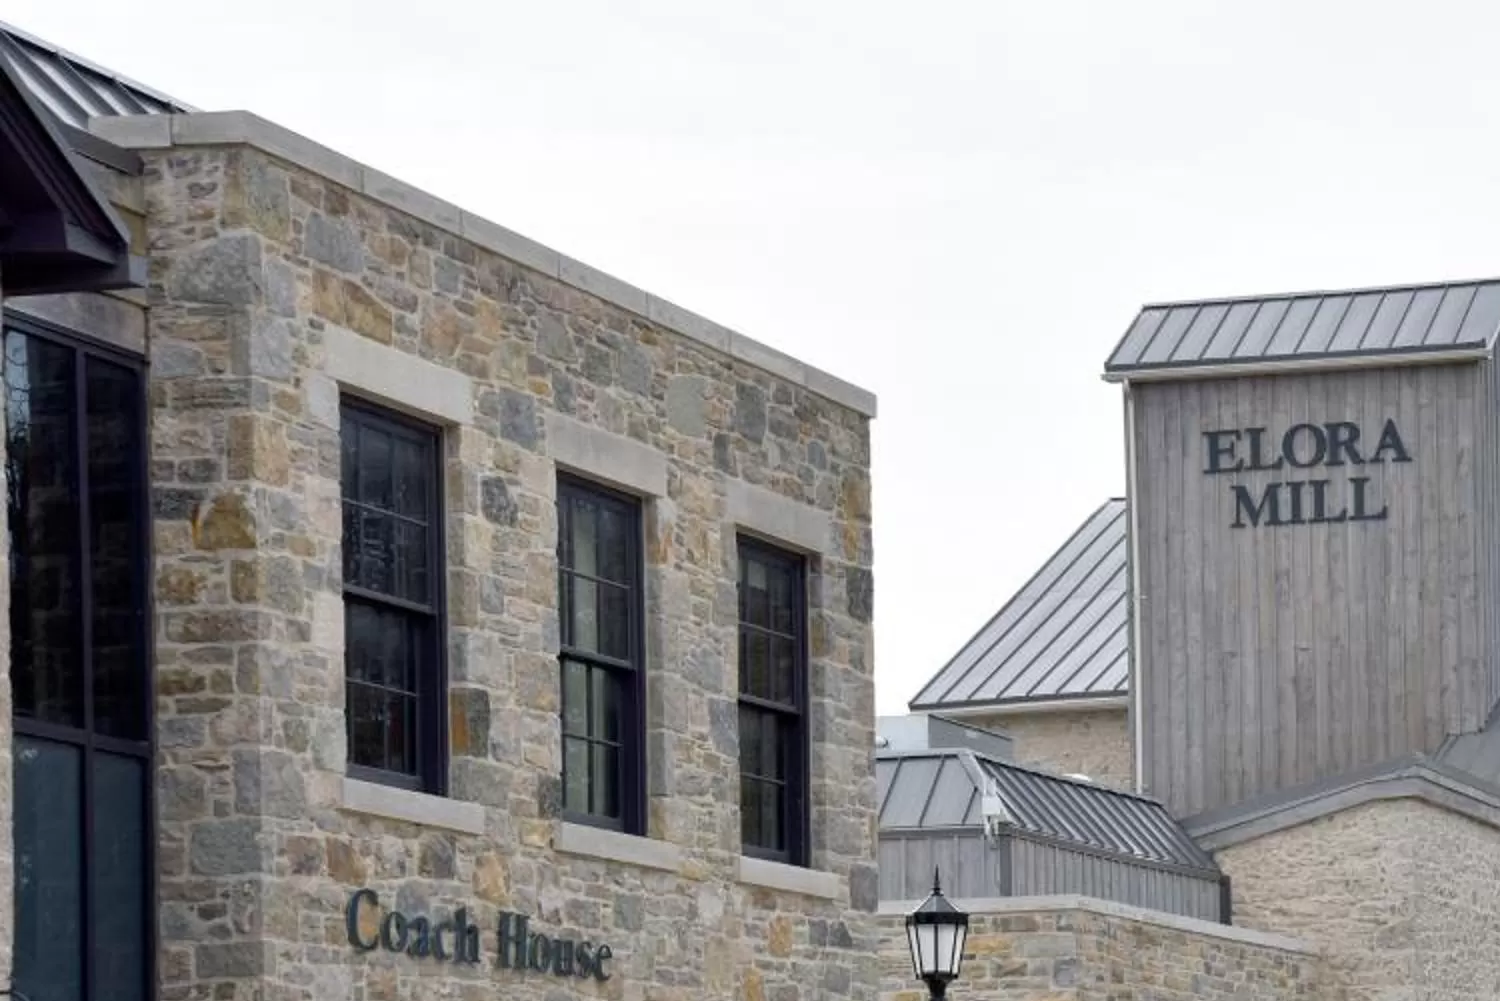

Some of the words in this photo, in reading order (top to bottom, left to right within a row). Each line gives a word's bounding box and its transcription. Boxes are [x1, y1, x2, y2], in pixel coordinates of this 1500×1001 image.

[1202, 418, 1412, 474] ELORA
[1230, 477, 1388, 528] MILL
[346, 888, 480, 964] Coach
[497, 910, 612, 981] House
